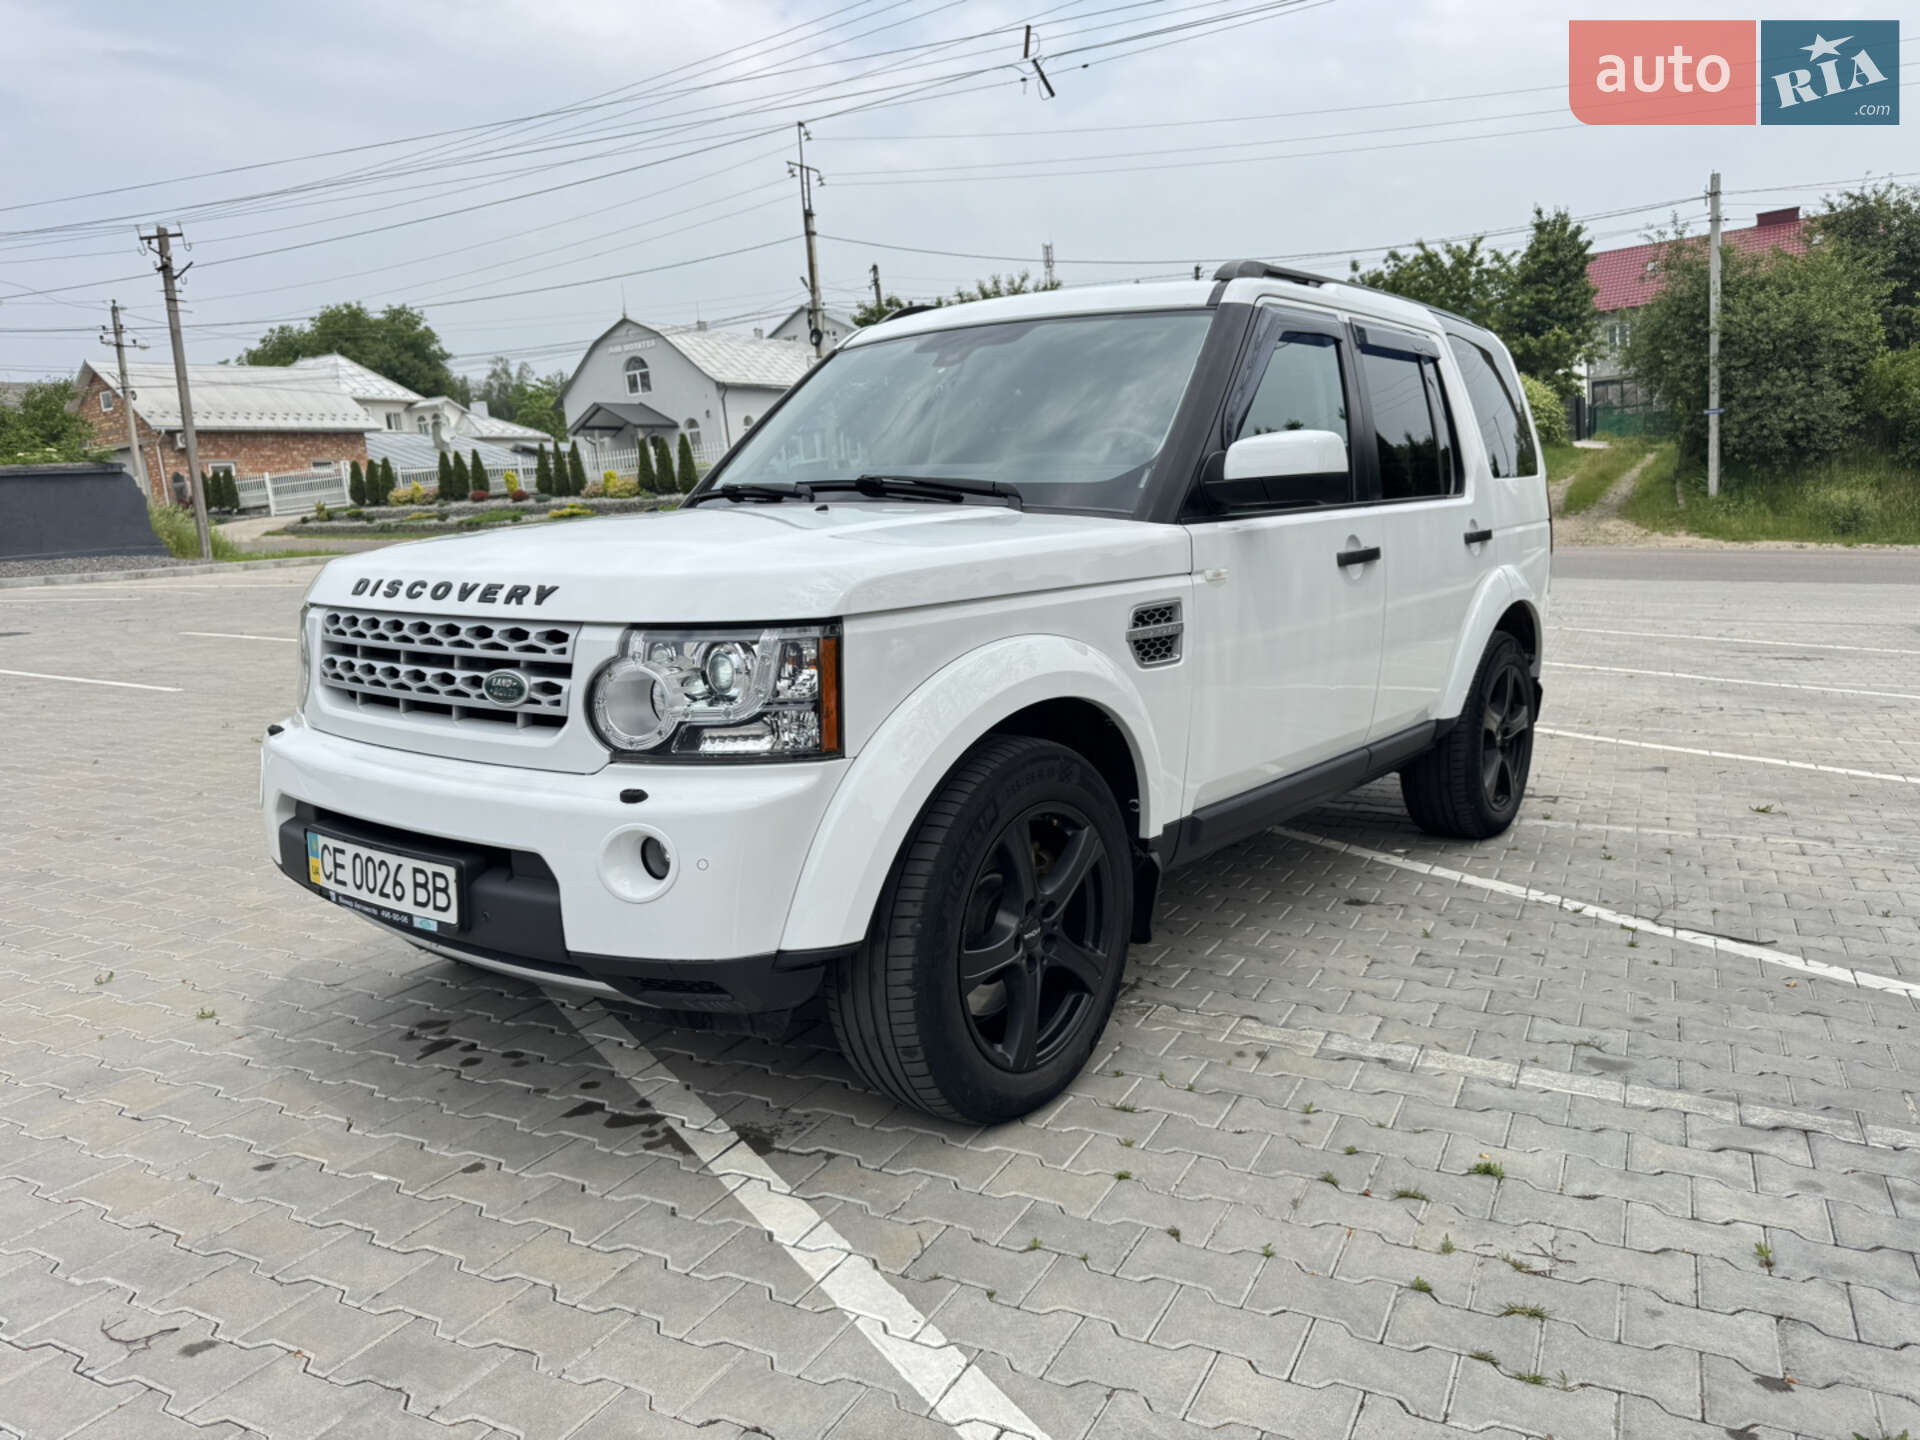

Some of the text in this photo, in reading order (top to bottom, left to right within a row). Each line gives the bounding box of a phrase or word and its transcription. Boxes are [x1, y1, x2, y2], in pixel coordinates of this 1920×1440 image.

[351, 577, 559, 606] DISCOVERY
[491, 677, 513, 688] LAND
[320, 843, 347, 887] CE
[352, 853, 406, 902] 0026
[412, 867, 452, 913] BB
